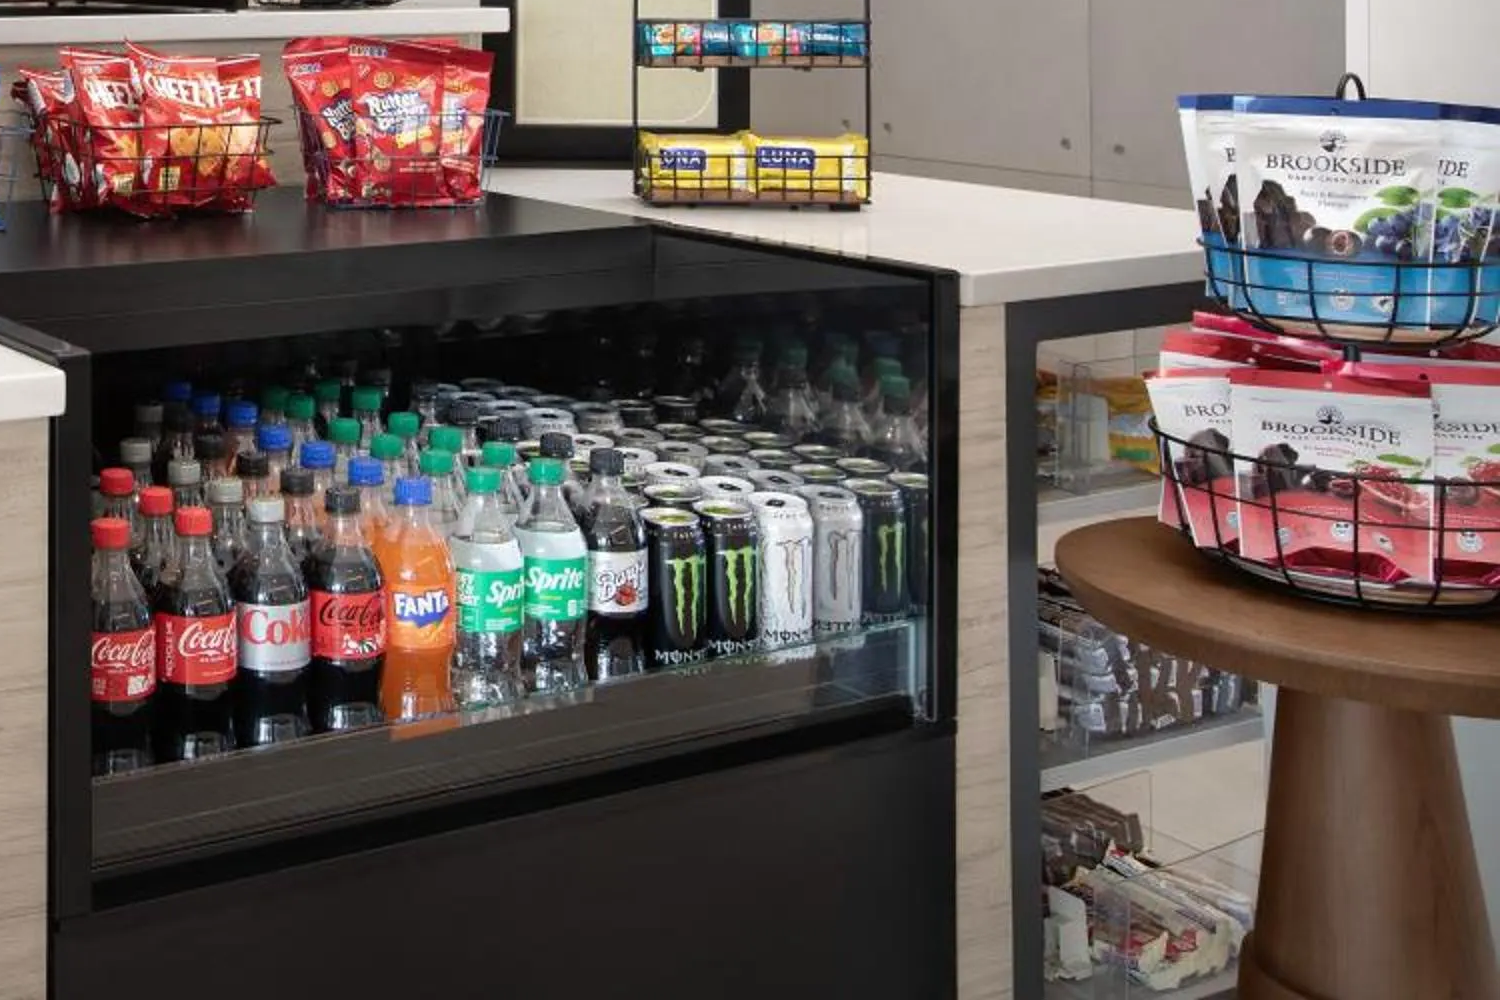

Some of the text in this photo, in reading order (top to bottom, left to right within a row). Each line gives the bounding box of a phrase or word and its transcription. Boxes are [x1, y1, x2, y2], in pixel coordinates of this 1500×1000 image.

[662, 150, 701, 165] UNA
[760, 149, 812, 165] LUNA
[1266, 153, 1407, 178] BROOKSIDE
[1261, 419, 1400, 445] BROOKSIDE
[485, 575, 524, 608] Spri
[524, 566, 583, 593] Sprite
[242, 606, 311, 646] Cok
